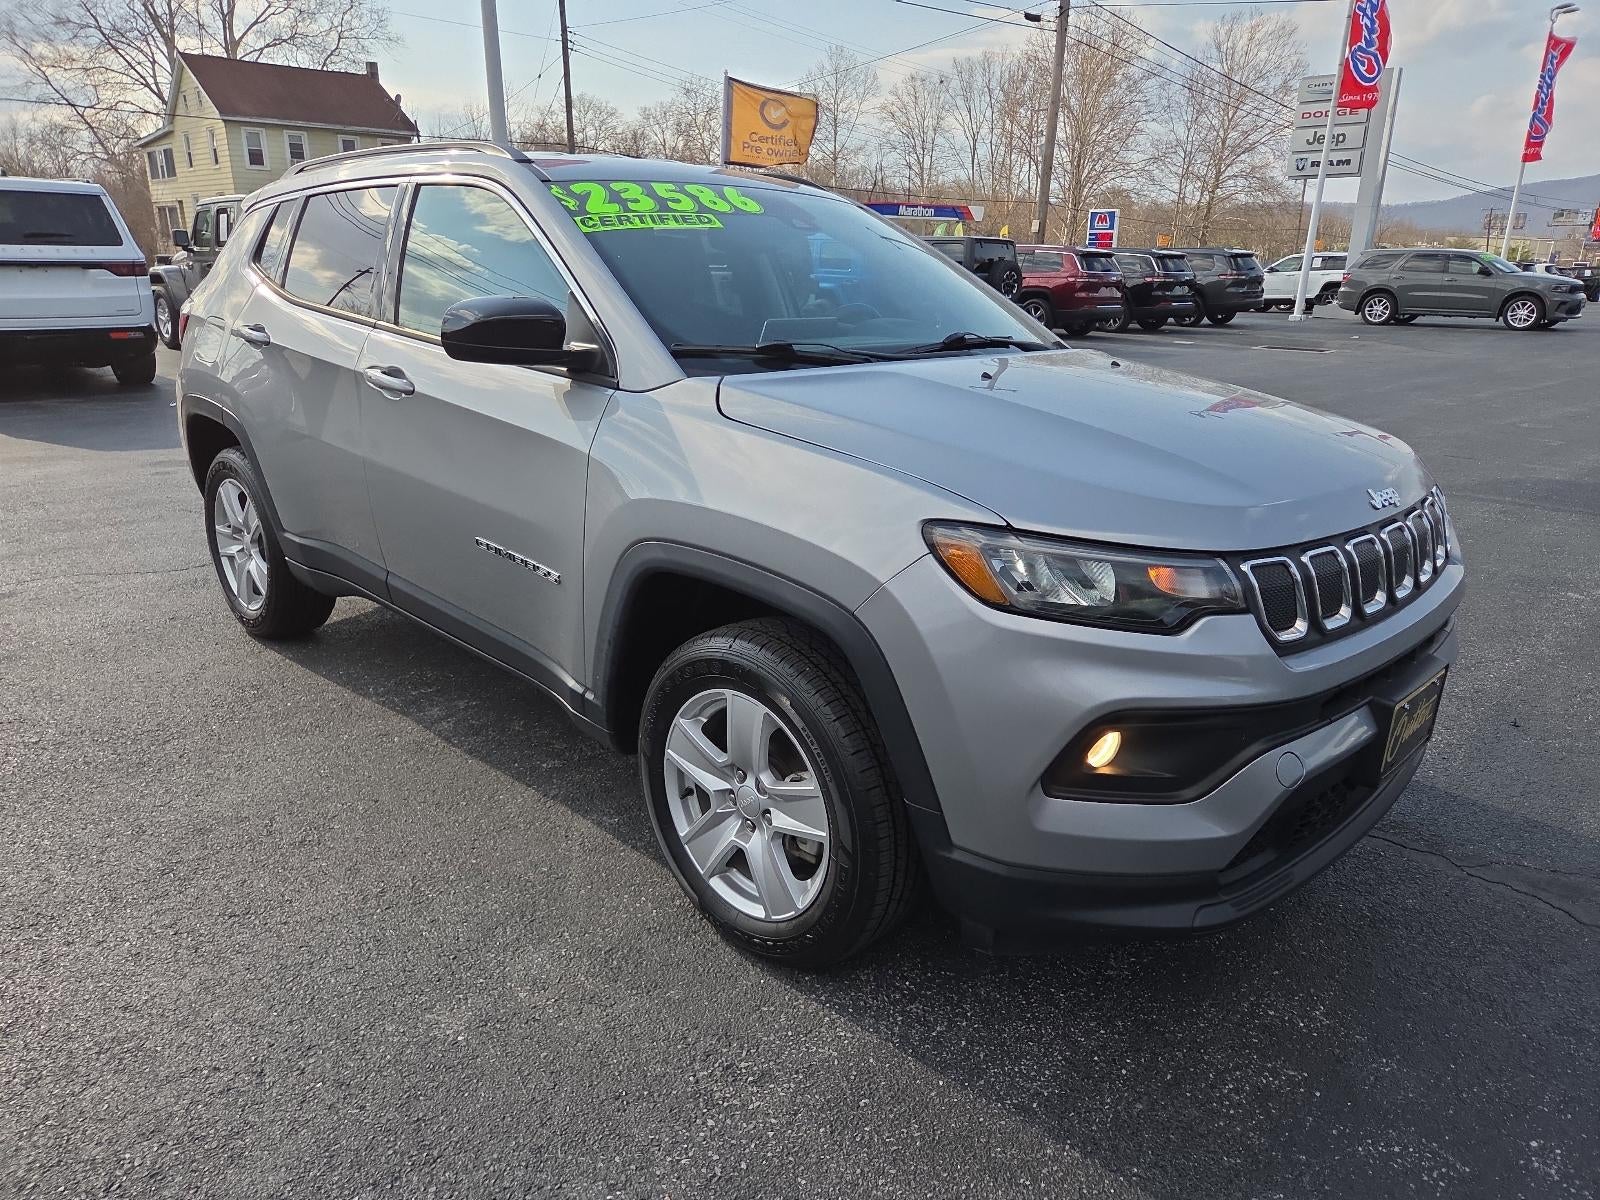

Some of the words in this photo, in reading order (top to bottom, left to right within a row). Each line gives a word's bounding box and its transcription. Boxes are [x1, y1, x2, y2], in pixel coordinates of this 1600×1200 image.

[1362, 92, 1379, 102] 197
[1310, 158, 1352, 168] RAM
[898, 205, 934, 217] Marathon
[579, 214, 713, 229] CERTIFIED
[1367, 487, 1401, 510] Jeep
